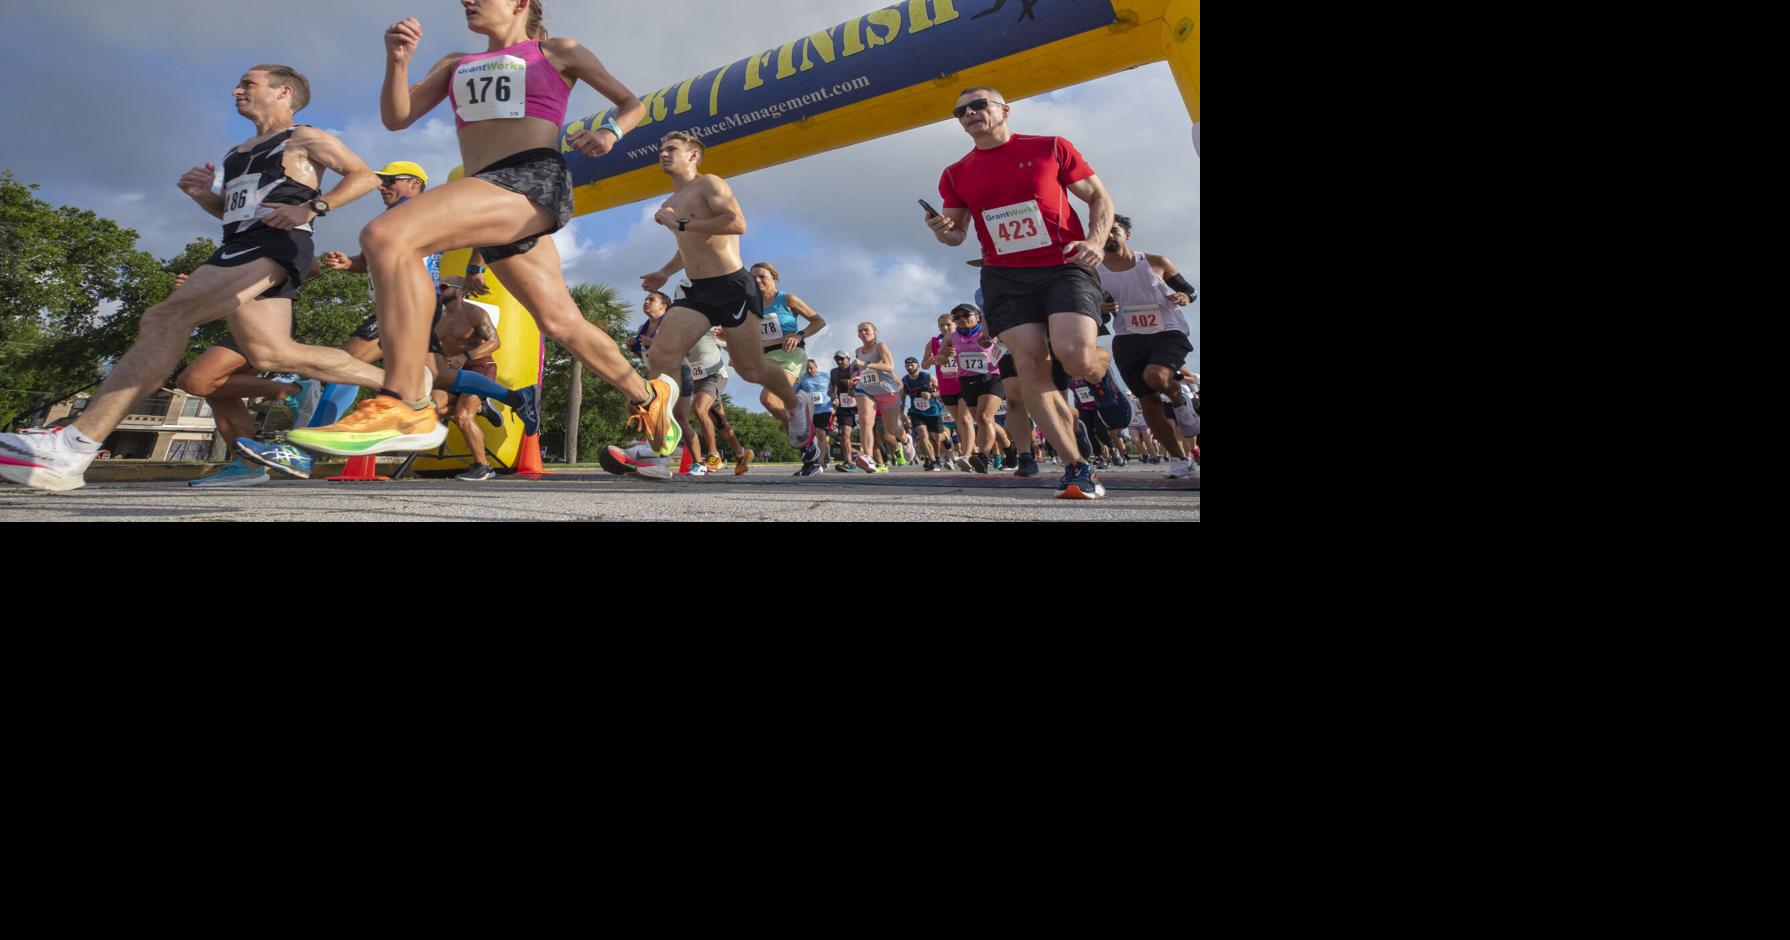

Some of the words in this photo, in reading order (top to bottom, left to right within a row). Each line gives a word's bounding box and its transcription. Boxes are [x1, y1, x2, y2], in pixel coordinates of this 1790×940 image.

[743, 0, 960, 91] FINISH
[466, 75, 511, 105] 176
[998, 217, 1038, 241] 423
[761, 321, 777, 335] 78
[1131, 314, 1158, 328] 402
[965, 359, 984, 369] 173
